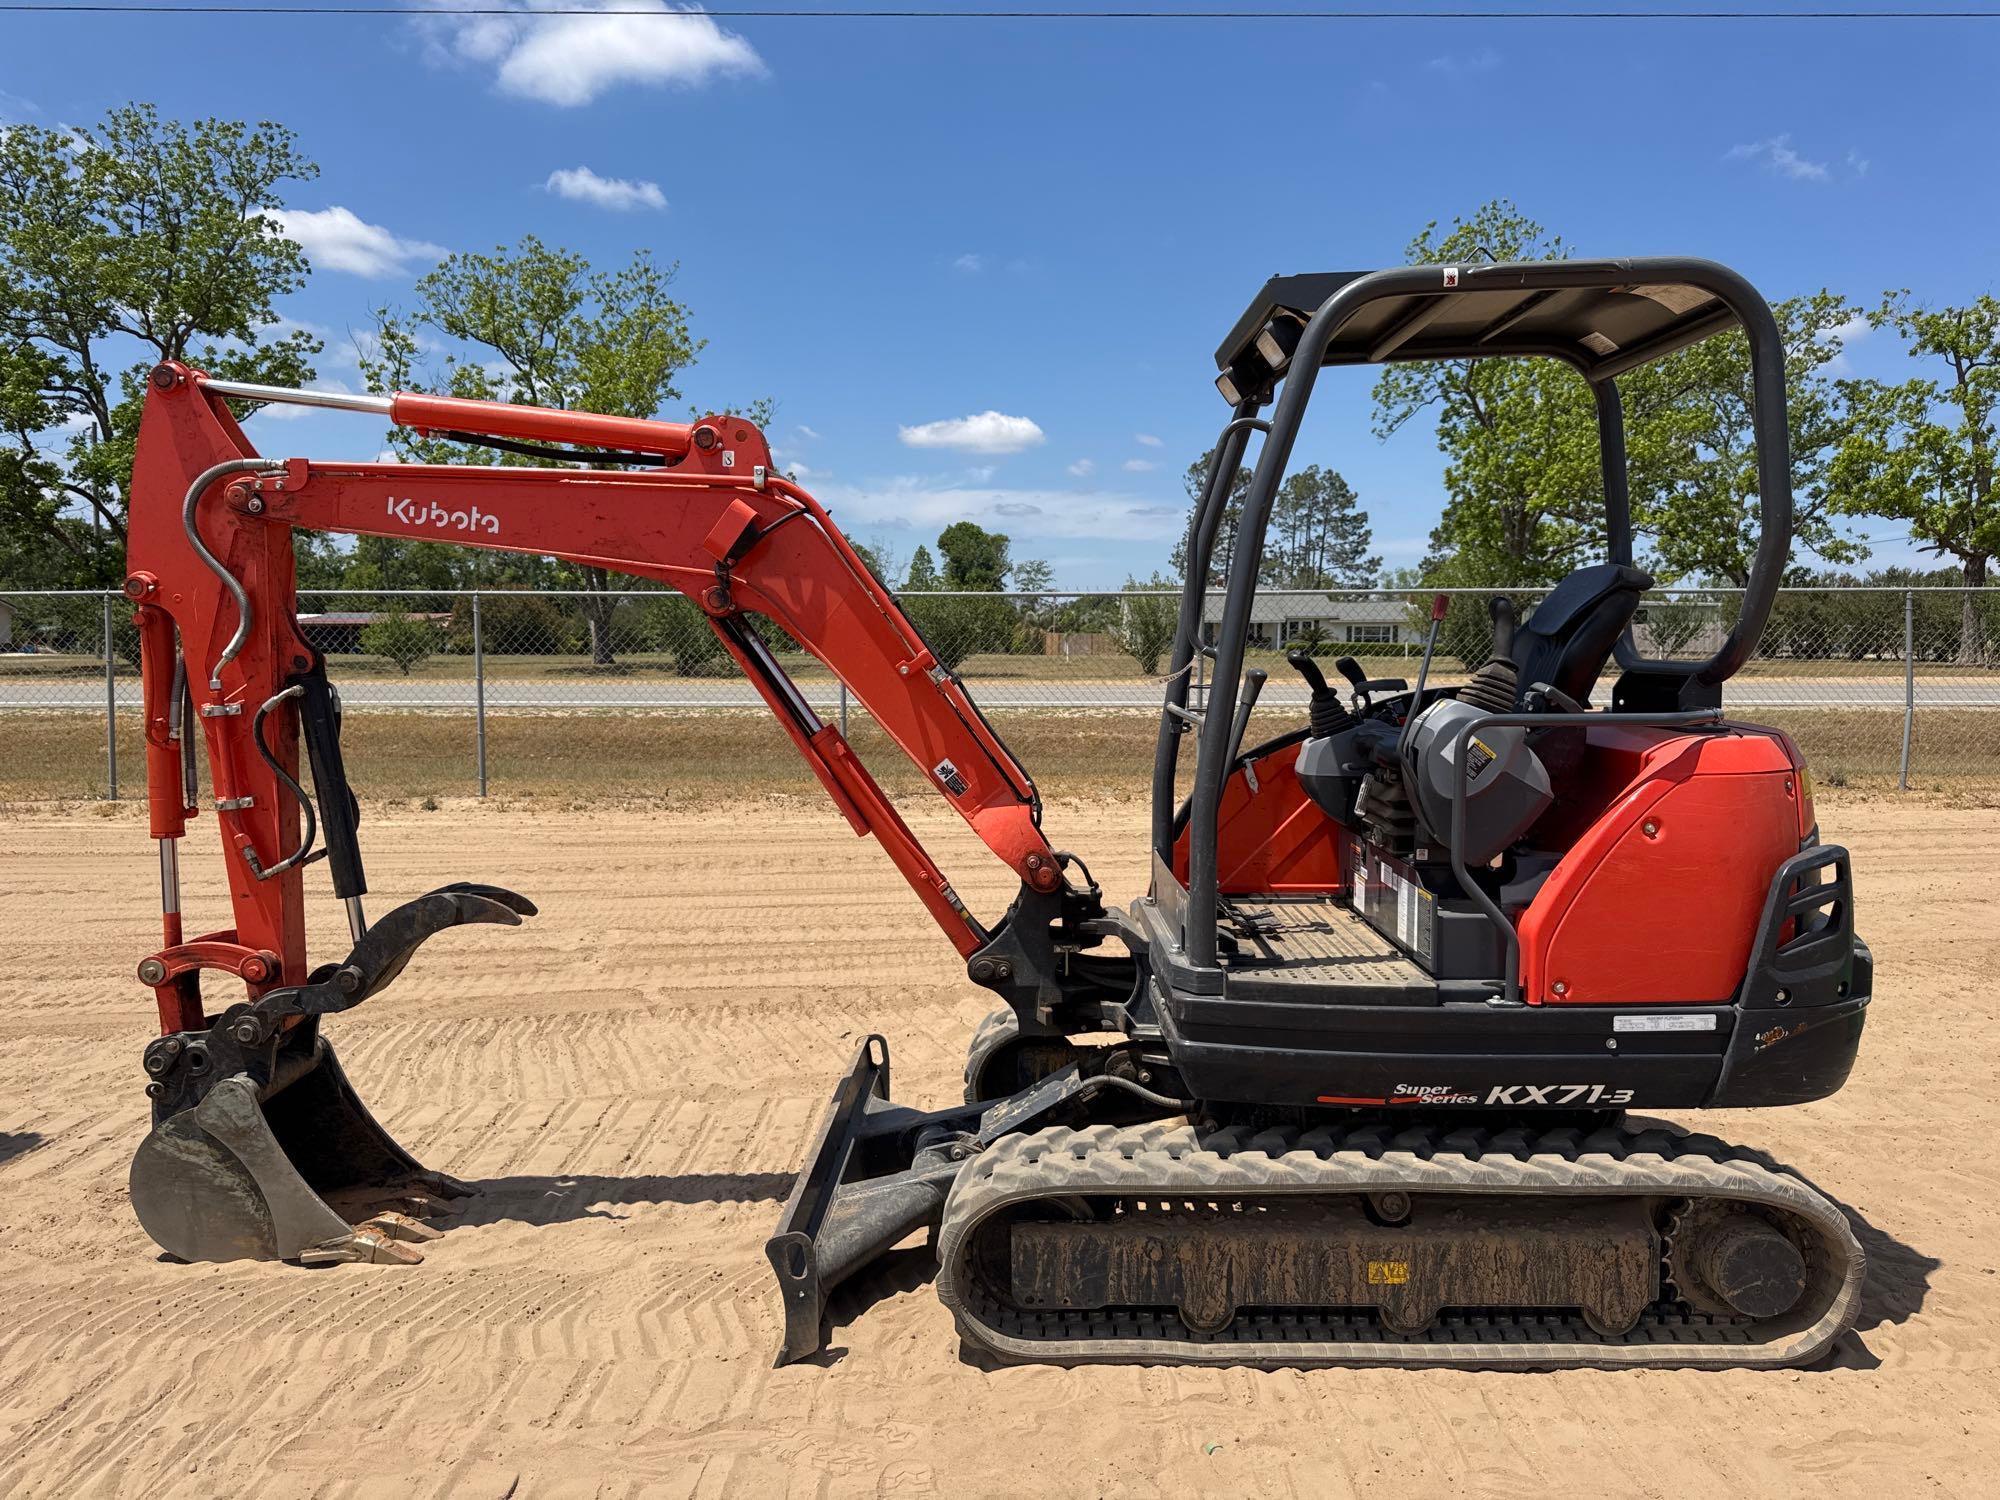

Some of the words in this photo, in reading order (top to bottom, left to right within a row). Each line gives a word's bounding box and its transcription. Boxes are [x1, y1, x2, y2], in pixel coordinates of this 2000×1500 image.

[387, 496, 500, 534] Kubota
[1393, 1083, 1452, 1098] Super
[1419, 1093, 1478, 1104] Series
[1484, 1084, 1635, 1105] KX71-3
